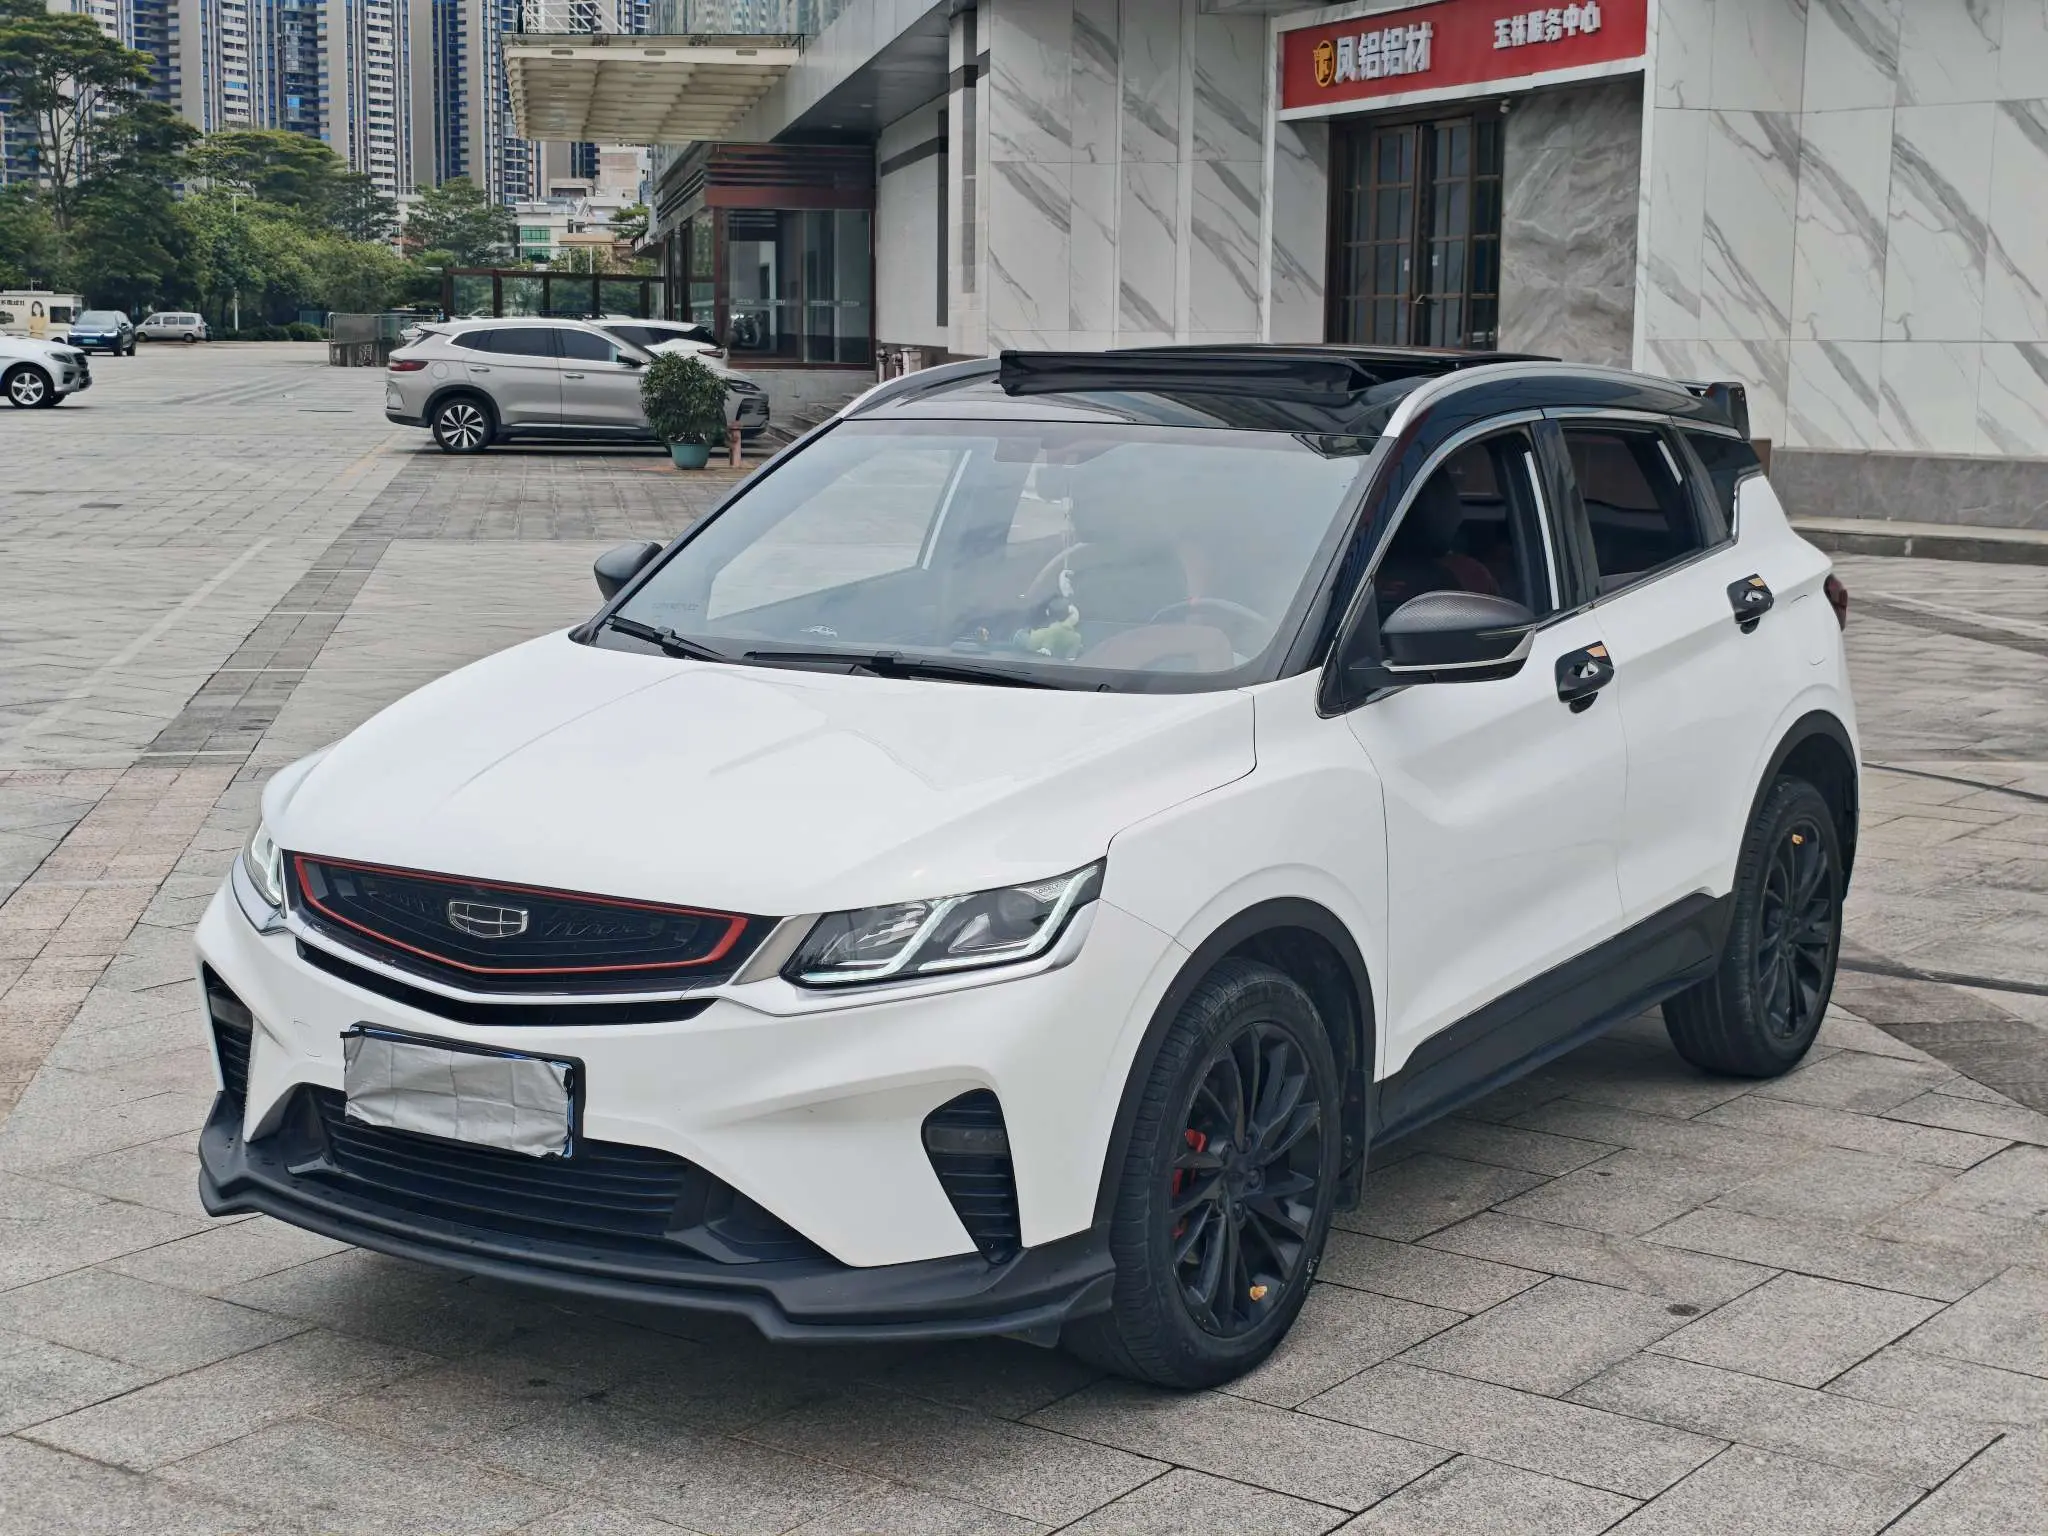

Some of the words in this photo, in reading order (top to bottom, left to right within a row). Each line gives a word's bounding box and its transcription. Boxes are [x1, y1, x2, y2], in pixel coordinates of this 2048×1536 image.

[1335, 21, 1433, 83] 凤铝铝材
[1493, 1, 1601, 49] 玉林服务中心
